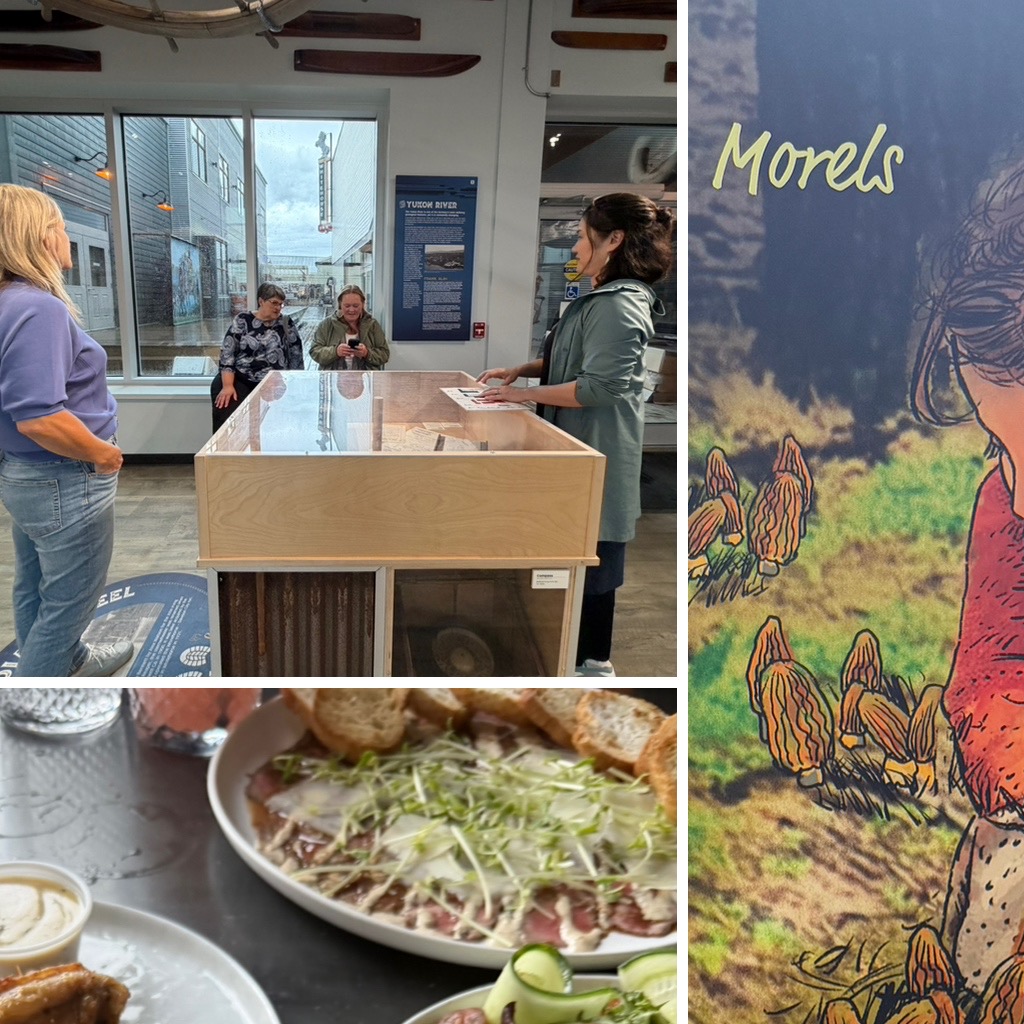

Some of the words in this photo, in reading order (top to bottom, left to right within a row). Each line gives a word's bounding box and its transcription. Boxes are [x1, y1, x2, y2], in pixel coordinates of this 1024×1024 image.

[712, 122, 904, 195] Morels
[406, 201, 433, 209] YUKON
[435, 201, 458, 209] RIVER
